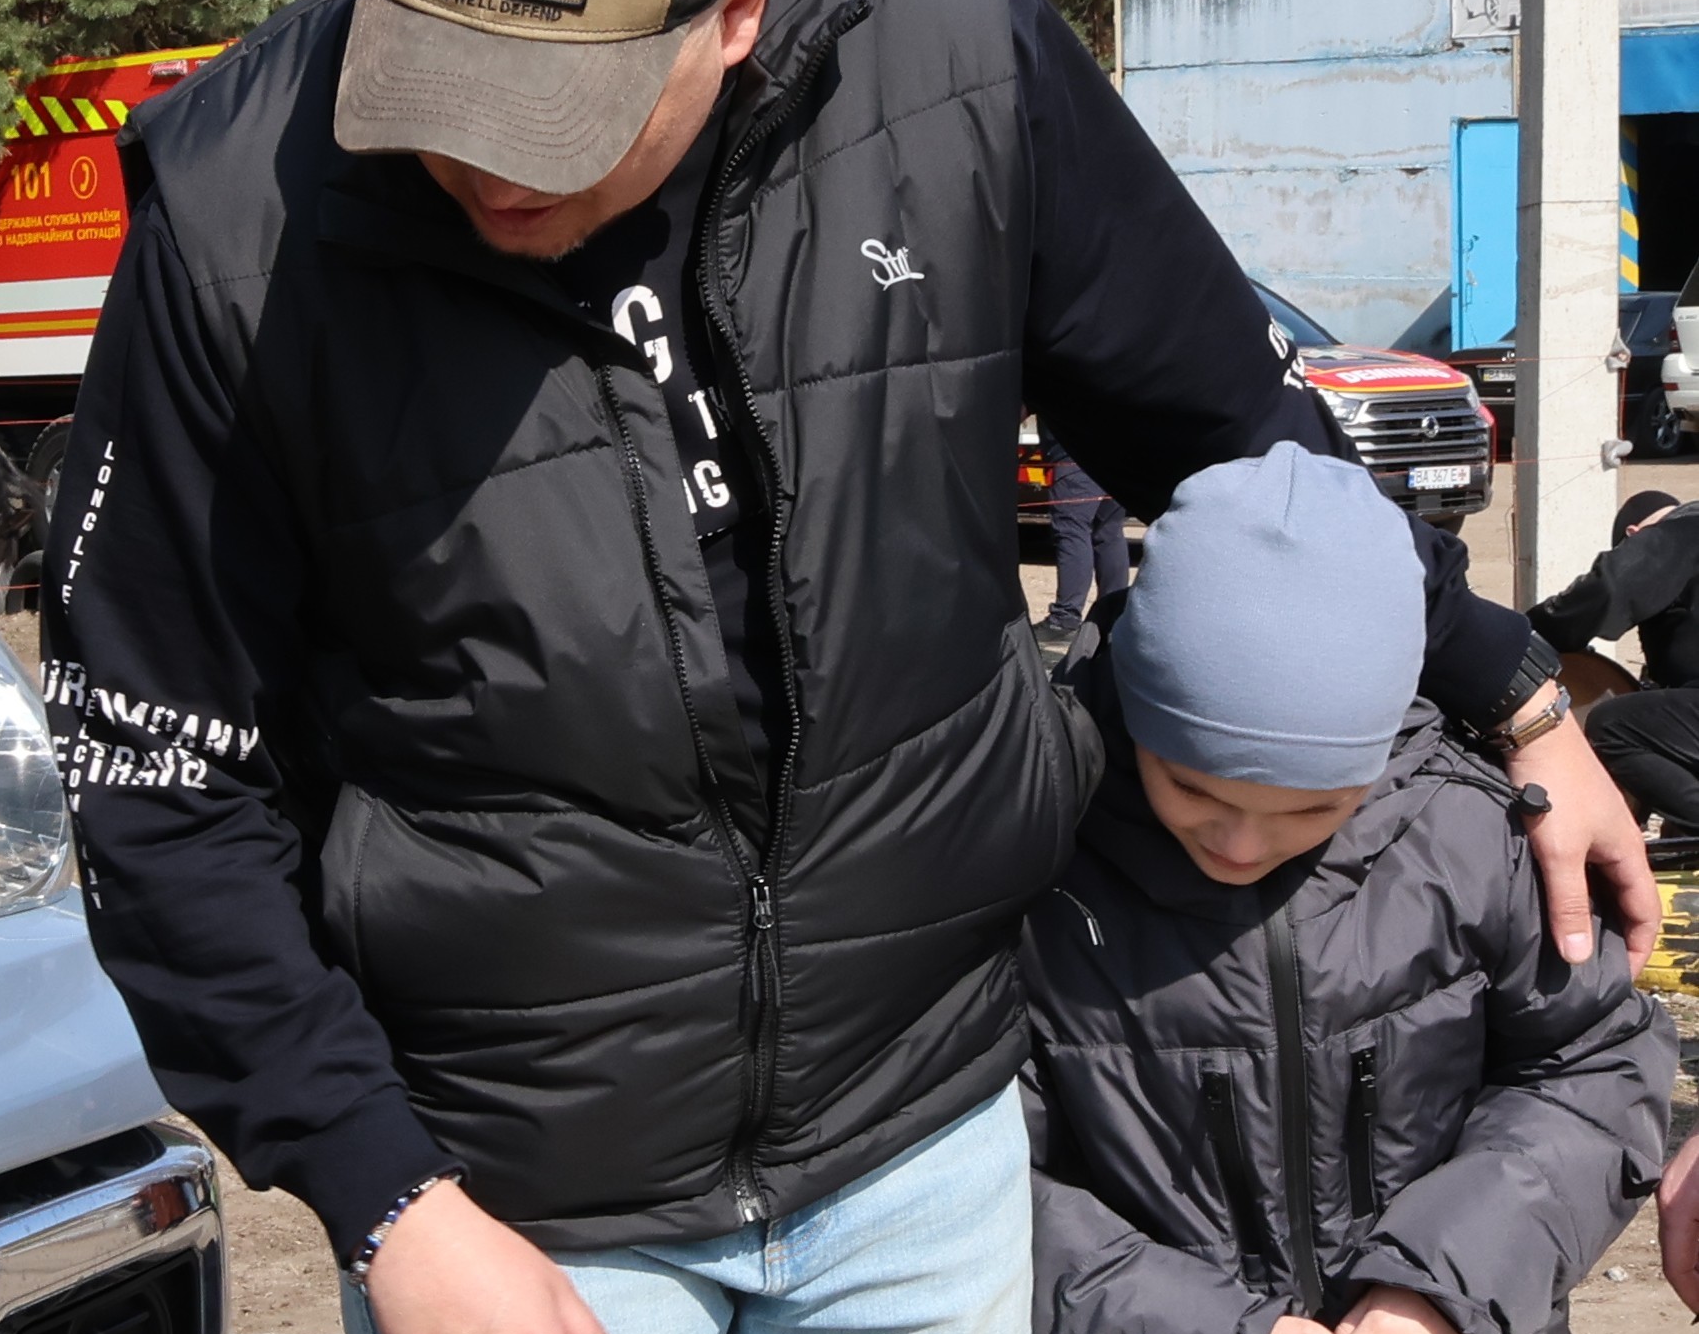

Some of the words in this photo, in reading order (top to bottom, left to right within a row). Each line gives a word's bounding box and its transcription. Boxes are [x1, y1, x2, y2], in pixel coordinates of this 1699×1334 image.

[499, 0, 563, 22] DEFEND
[11, 161, 51, 200] 101
[44, 213, 81, 226] СЛУЖБА
[82, 208, 121, 224] УКРАЇНИ
